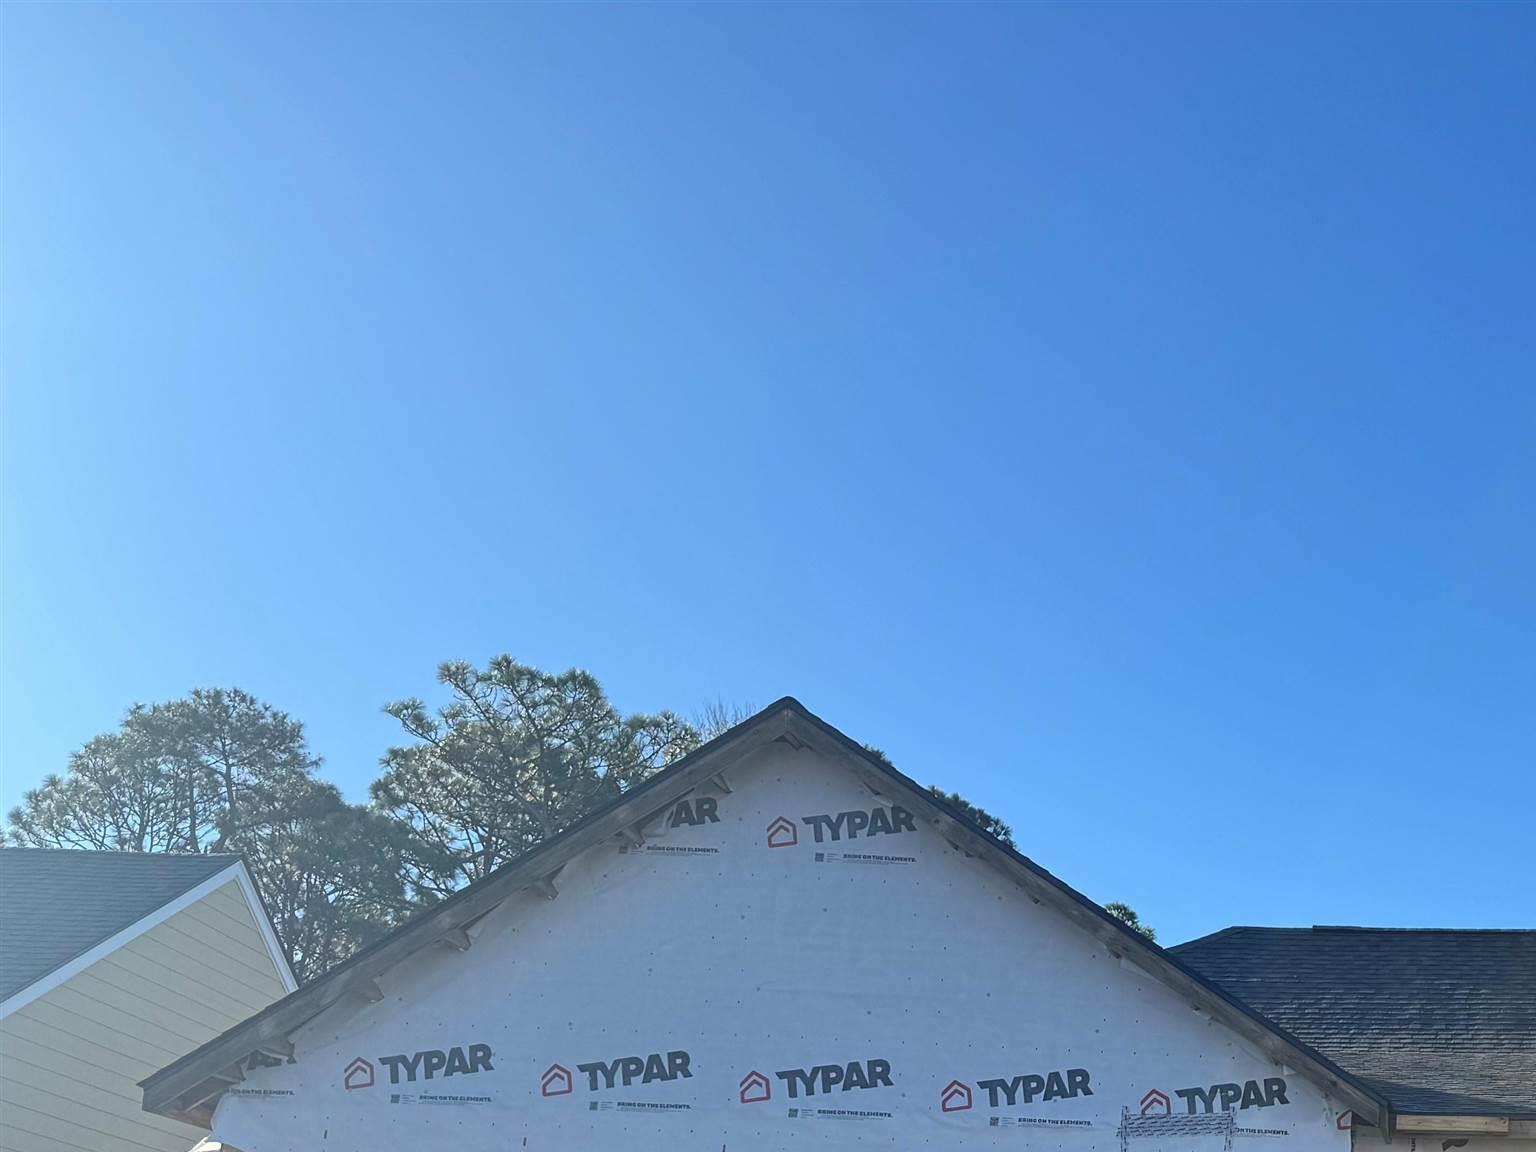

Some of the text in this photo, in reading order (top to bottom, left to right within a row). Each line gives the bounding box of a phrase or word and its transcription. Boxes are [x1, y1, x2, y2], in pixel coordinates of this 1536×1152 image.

[801, 805, 918, 843] TYPAR
[378, 1043, 495, 1084] TYPAR
[576, 1050, 694, 1091] TYPAR
[775, 1058, 894, 1098] TYPAR
[976, 1068, 1094, 1108] TYPAR
[1174, 1077, 1291, 1115] TYPAR
